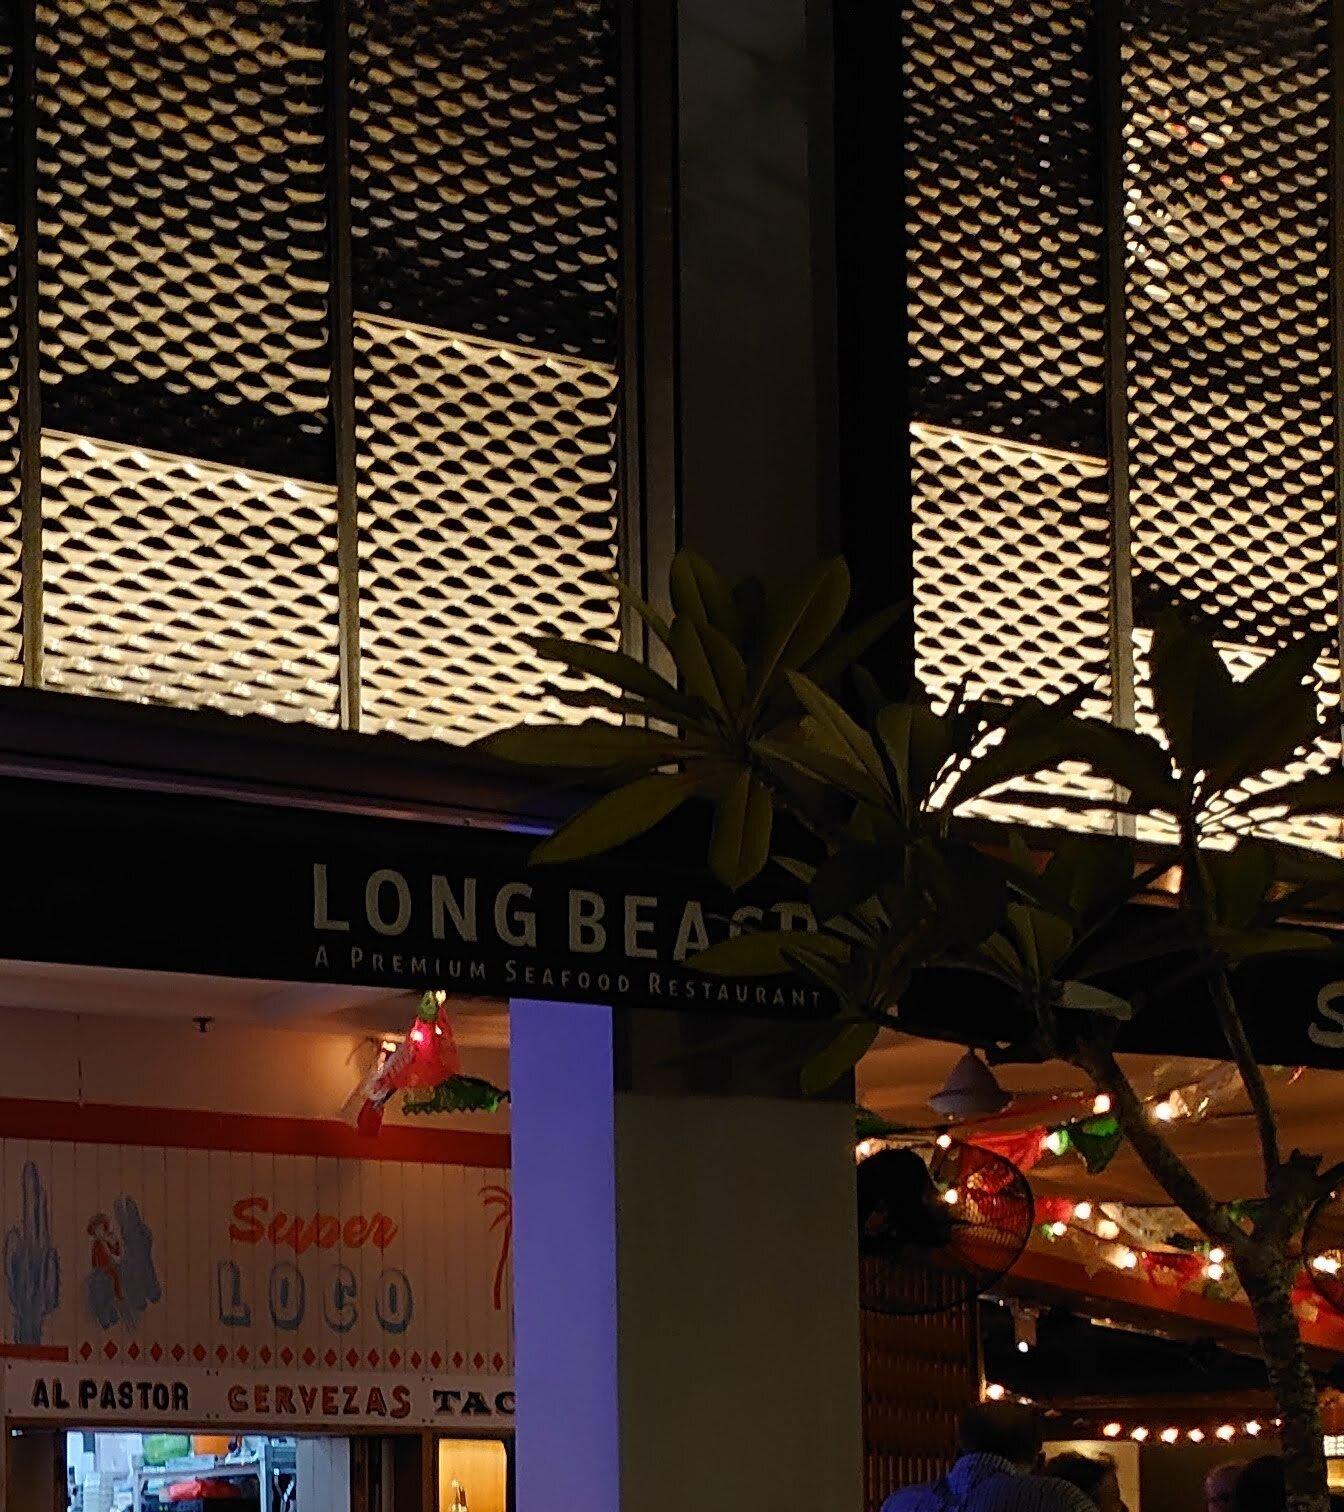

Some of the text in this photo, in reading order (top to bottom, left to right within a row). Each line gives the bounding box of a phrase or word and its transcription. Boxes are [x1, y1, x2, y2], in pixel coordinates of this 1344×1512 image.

[313, 862, 539, 954] LONG
[315, 945, 821, 1009] A PREMIUM SEAFOOD RESTAURANT
[228, 1196, 399, 1255] Super
[216, 1260, 414, 1335] LOCO
[30, 1378, 190, 1413] AL PASTOR
[227, 1384, 413, 1419] CERVEZAS
